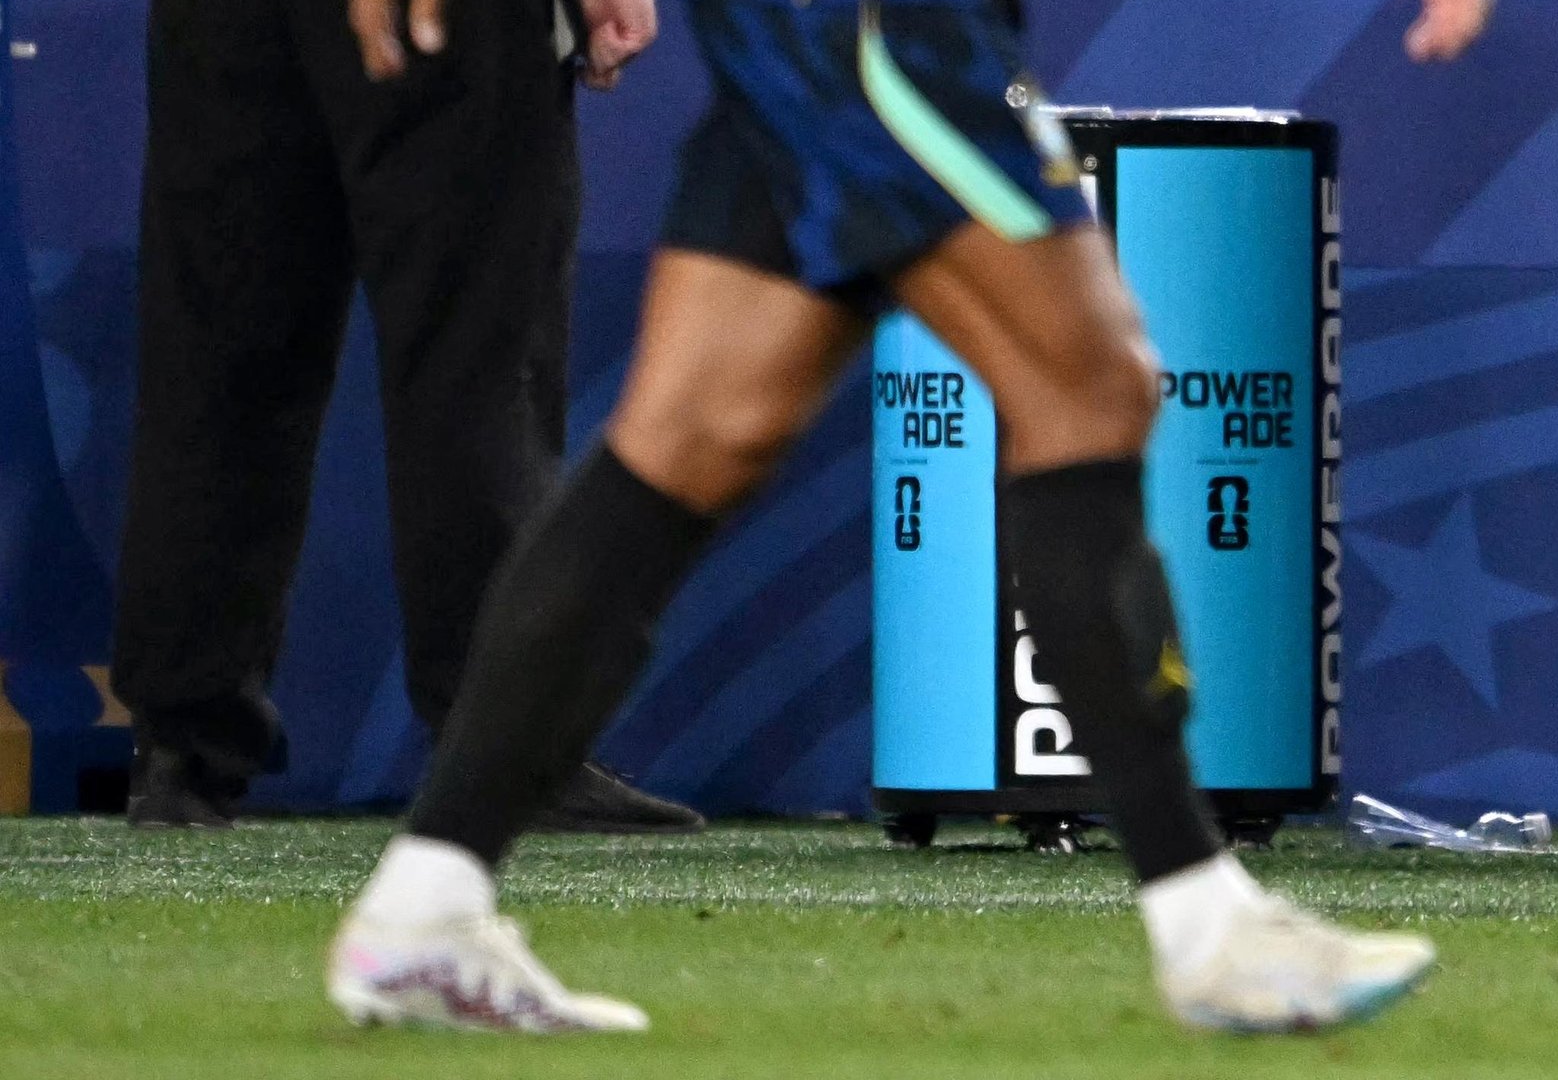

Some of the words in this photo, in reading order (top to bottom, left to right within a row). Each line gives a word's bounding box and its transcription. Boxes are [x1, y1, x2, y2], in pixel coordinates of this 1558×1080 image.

[876, 372, 964, 409] POWER
[1158, 371, 1294, 409] POWER
[904, 412, 966, 449] ADE
[1223, 411, 1294, 448] ADE
